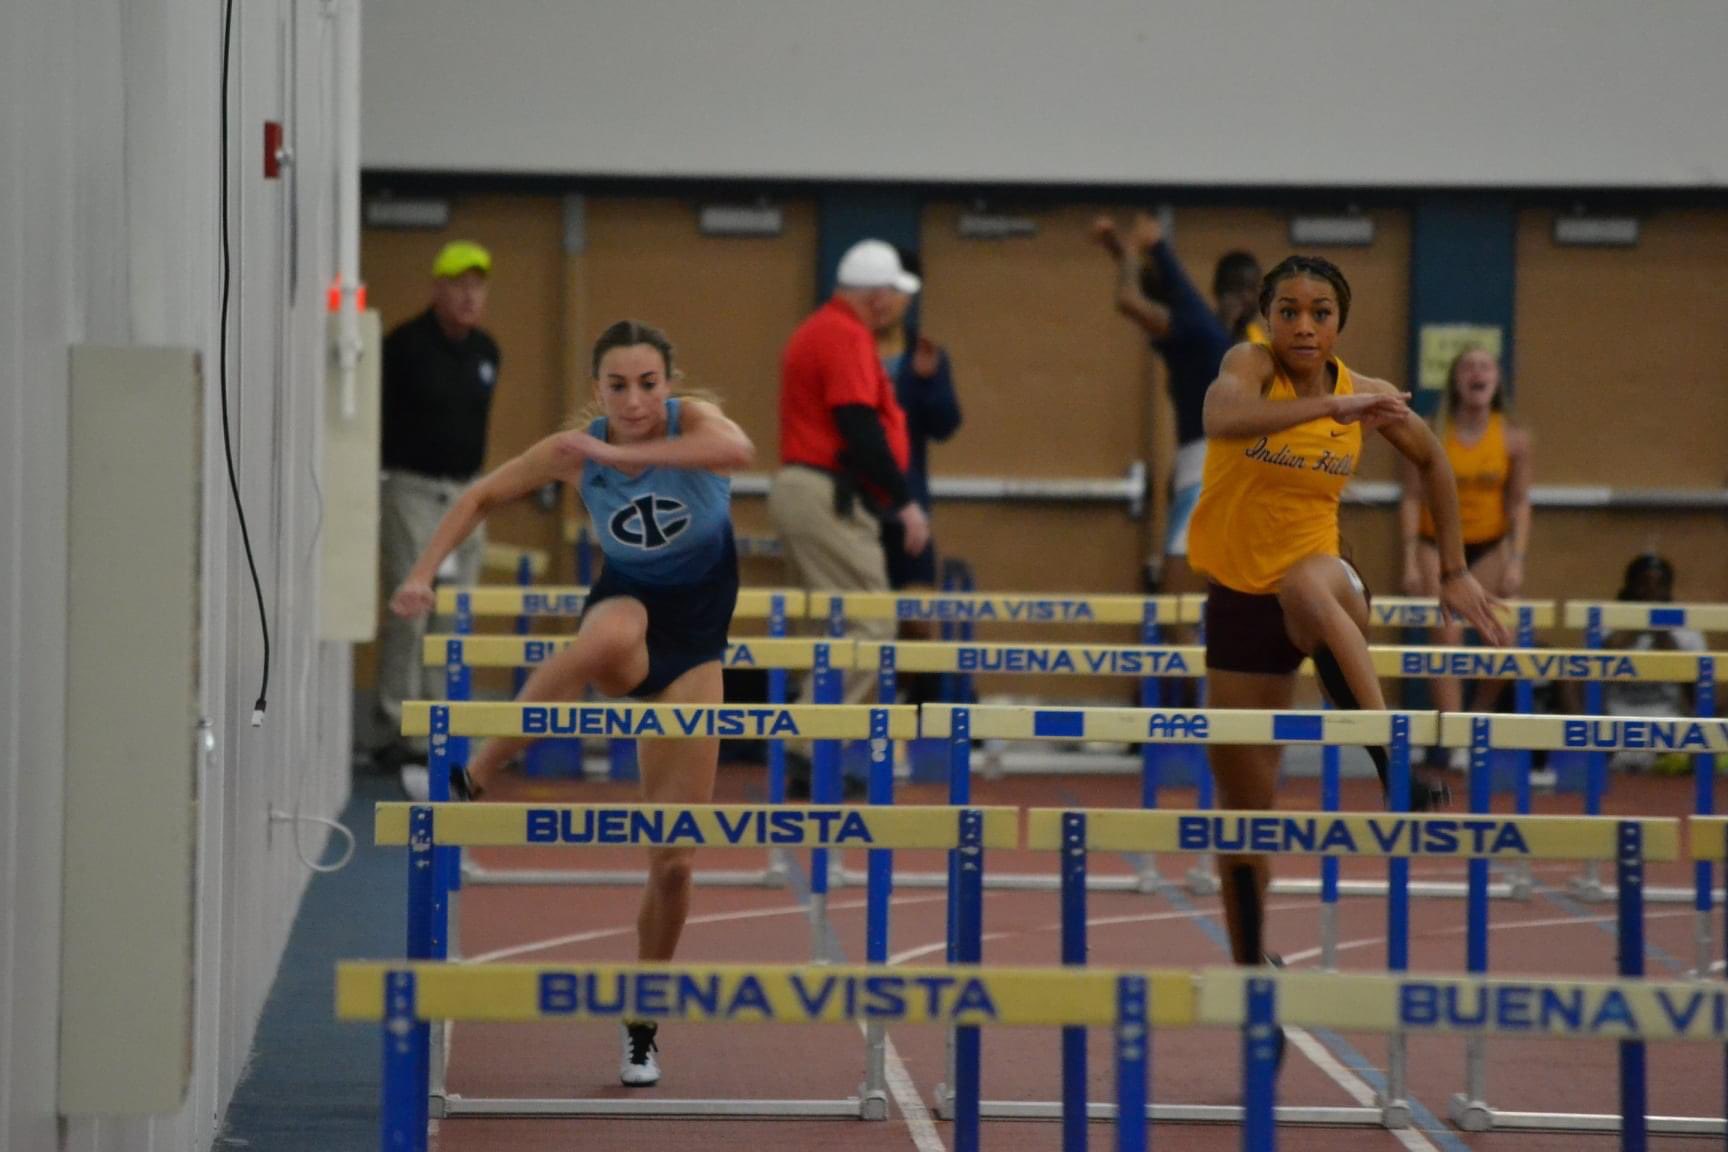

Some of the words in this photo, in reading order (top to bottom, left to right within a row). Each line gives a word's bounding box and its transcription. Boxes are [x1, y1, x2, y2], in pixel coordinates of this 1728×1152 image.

[1245, 437, 1305, 469] Indian
[523, 594, 584, 614] BUE
[896, 599, 997, 620] BUENA
[1003, 601, 1094, 621] VISTA
[957, 648, 1075, 672] BUENA
[1083, 651, 1188, 673] VISTA
[1402, 652, 1522, 676] BUENA
[1530, 655, 1638, 678] VISTA
[522, 707, 665, 735] BUENA
[673, 708, 799, 736] VISTA
[1565, 720, 1710, 748] BUENA
[526, 810, 706, 844] BUENA
[714, 810, 872, 844] VISTA
[1179, 816, 1358, 853] BUENA
[1369, 818, 1529, 854] VISTA
[538, 971, 775, 1017] BUENA
[790, 974, 998, 1019] VISTA
[1400, 984, 1638, 1032] BUENA
